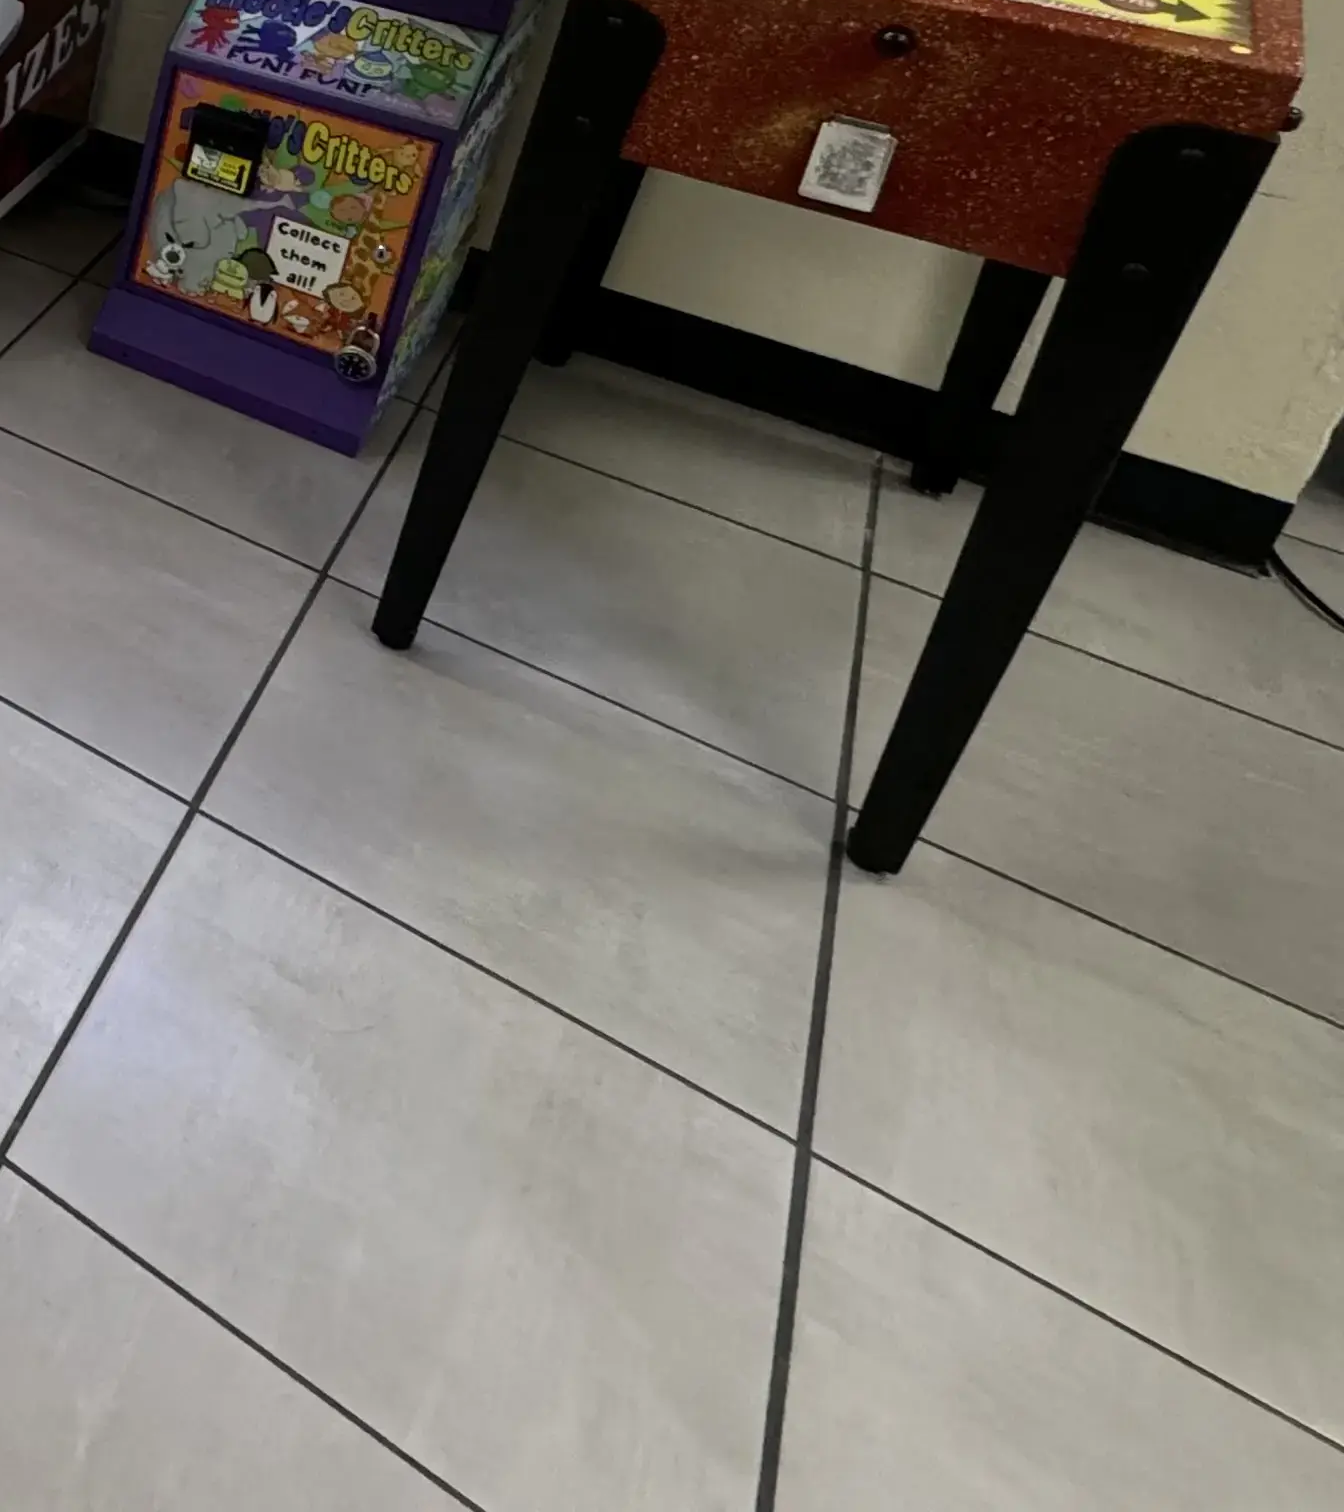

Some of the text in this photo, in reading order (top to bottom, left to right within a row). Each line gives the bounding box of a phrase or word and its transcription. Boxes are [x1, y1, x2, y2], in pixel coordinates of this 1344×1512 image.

[344, 5, 474, 71] Critters
[226, 45, 376, 99] FUN! FUN!
[301, 120, 413, 196] Critters
[277, 221, 342, 254] Collect
[279, 246, 328, 273] them
[285, 269, 318, 292] all!
